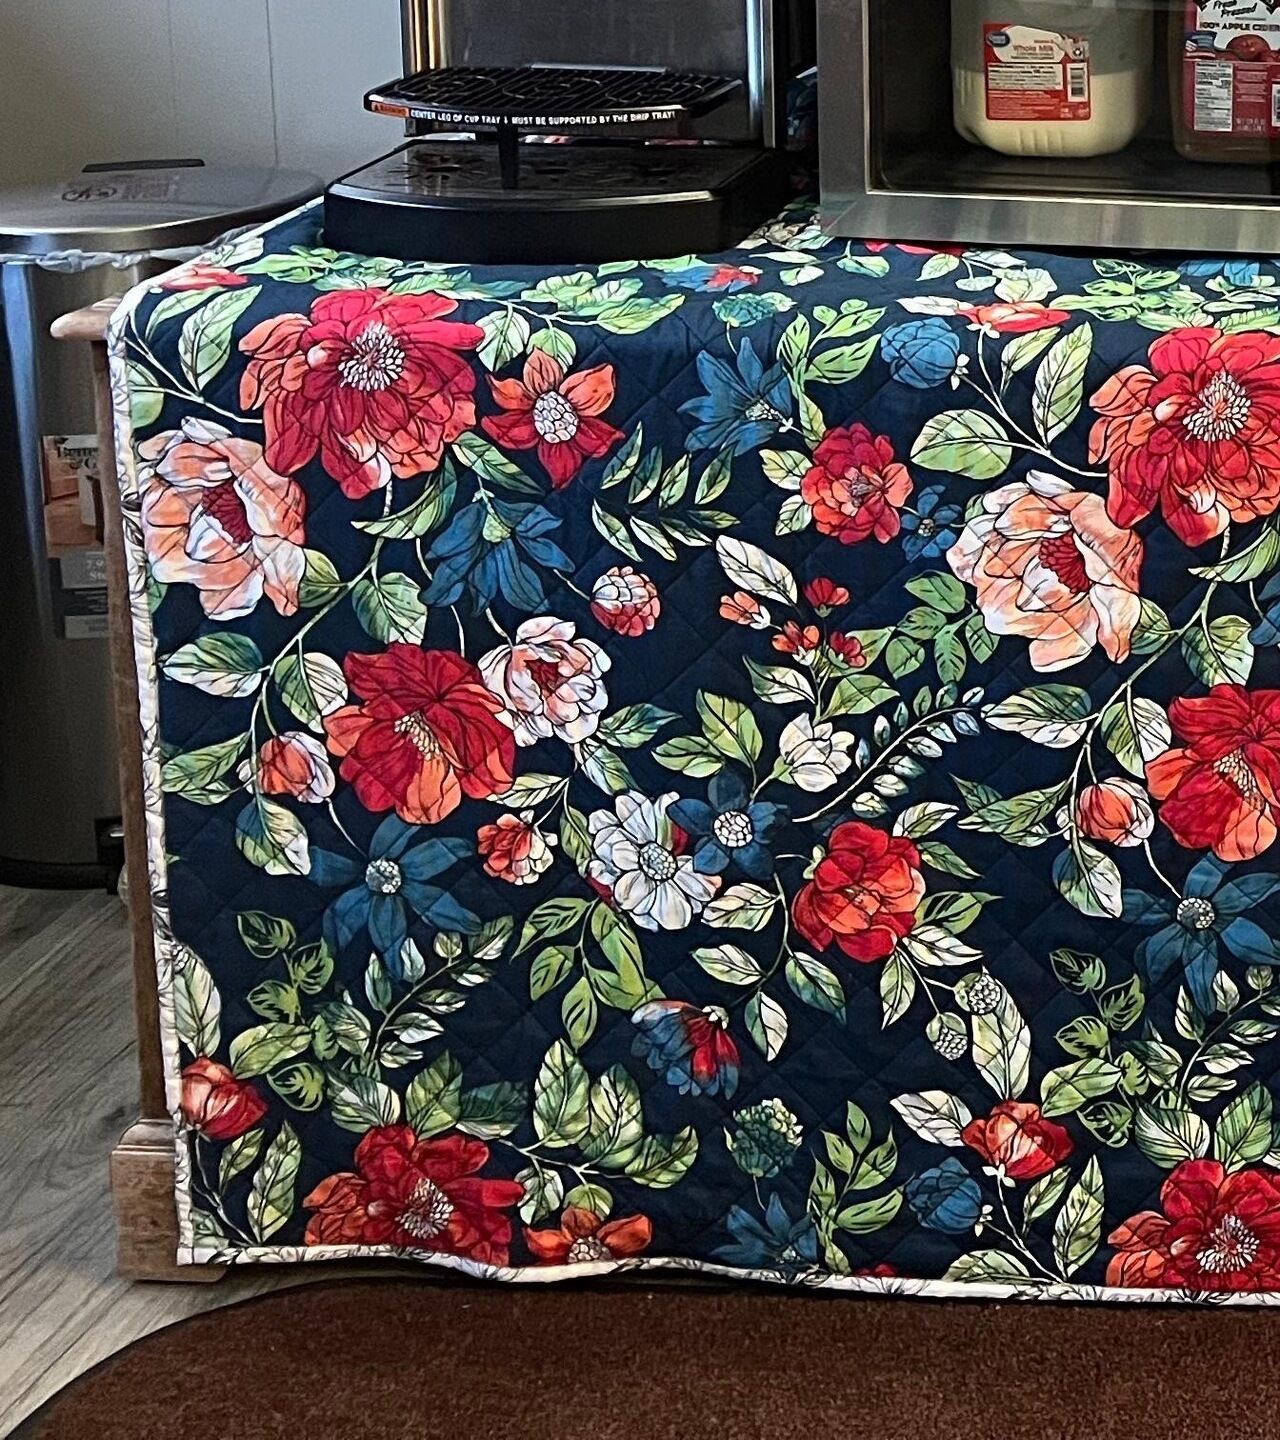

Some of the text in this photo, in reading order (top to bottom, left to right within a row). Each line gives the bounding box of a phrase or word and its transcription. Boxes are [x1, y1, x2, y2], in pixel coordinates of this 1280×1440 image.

[1252, 24, 1280, 32] CIDER
[410, 110, 436, 120] CENTER
[464, 114, 479, 123] CUP
[481, 115, 500, 124] TRAY
[511, 116, 533, 125] MUST
[535, 116, 546, 125] BE
[548, 116, 597, 125] SUPPORTED
[600, 115, 610, 124] BY
[612, 114, 628, 123] THE
[630, 112, 650, 122] DRIP
